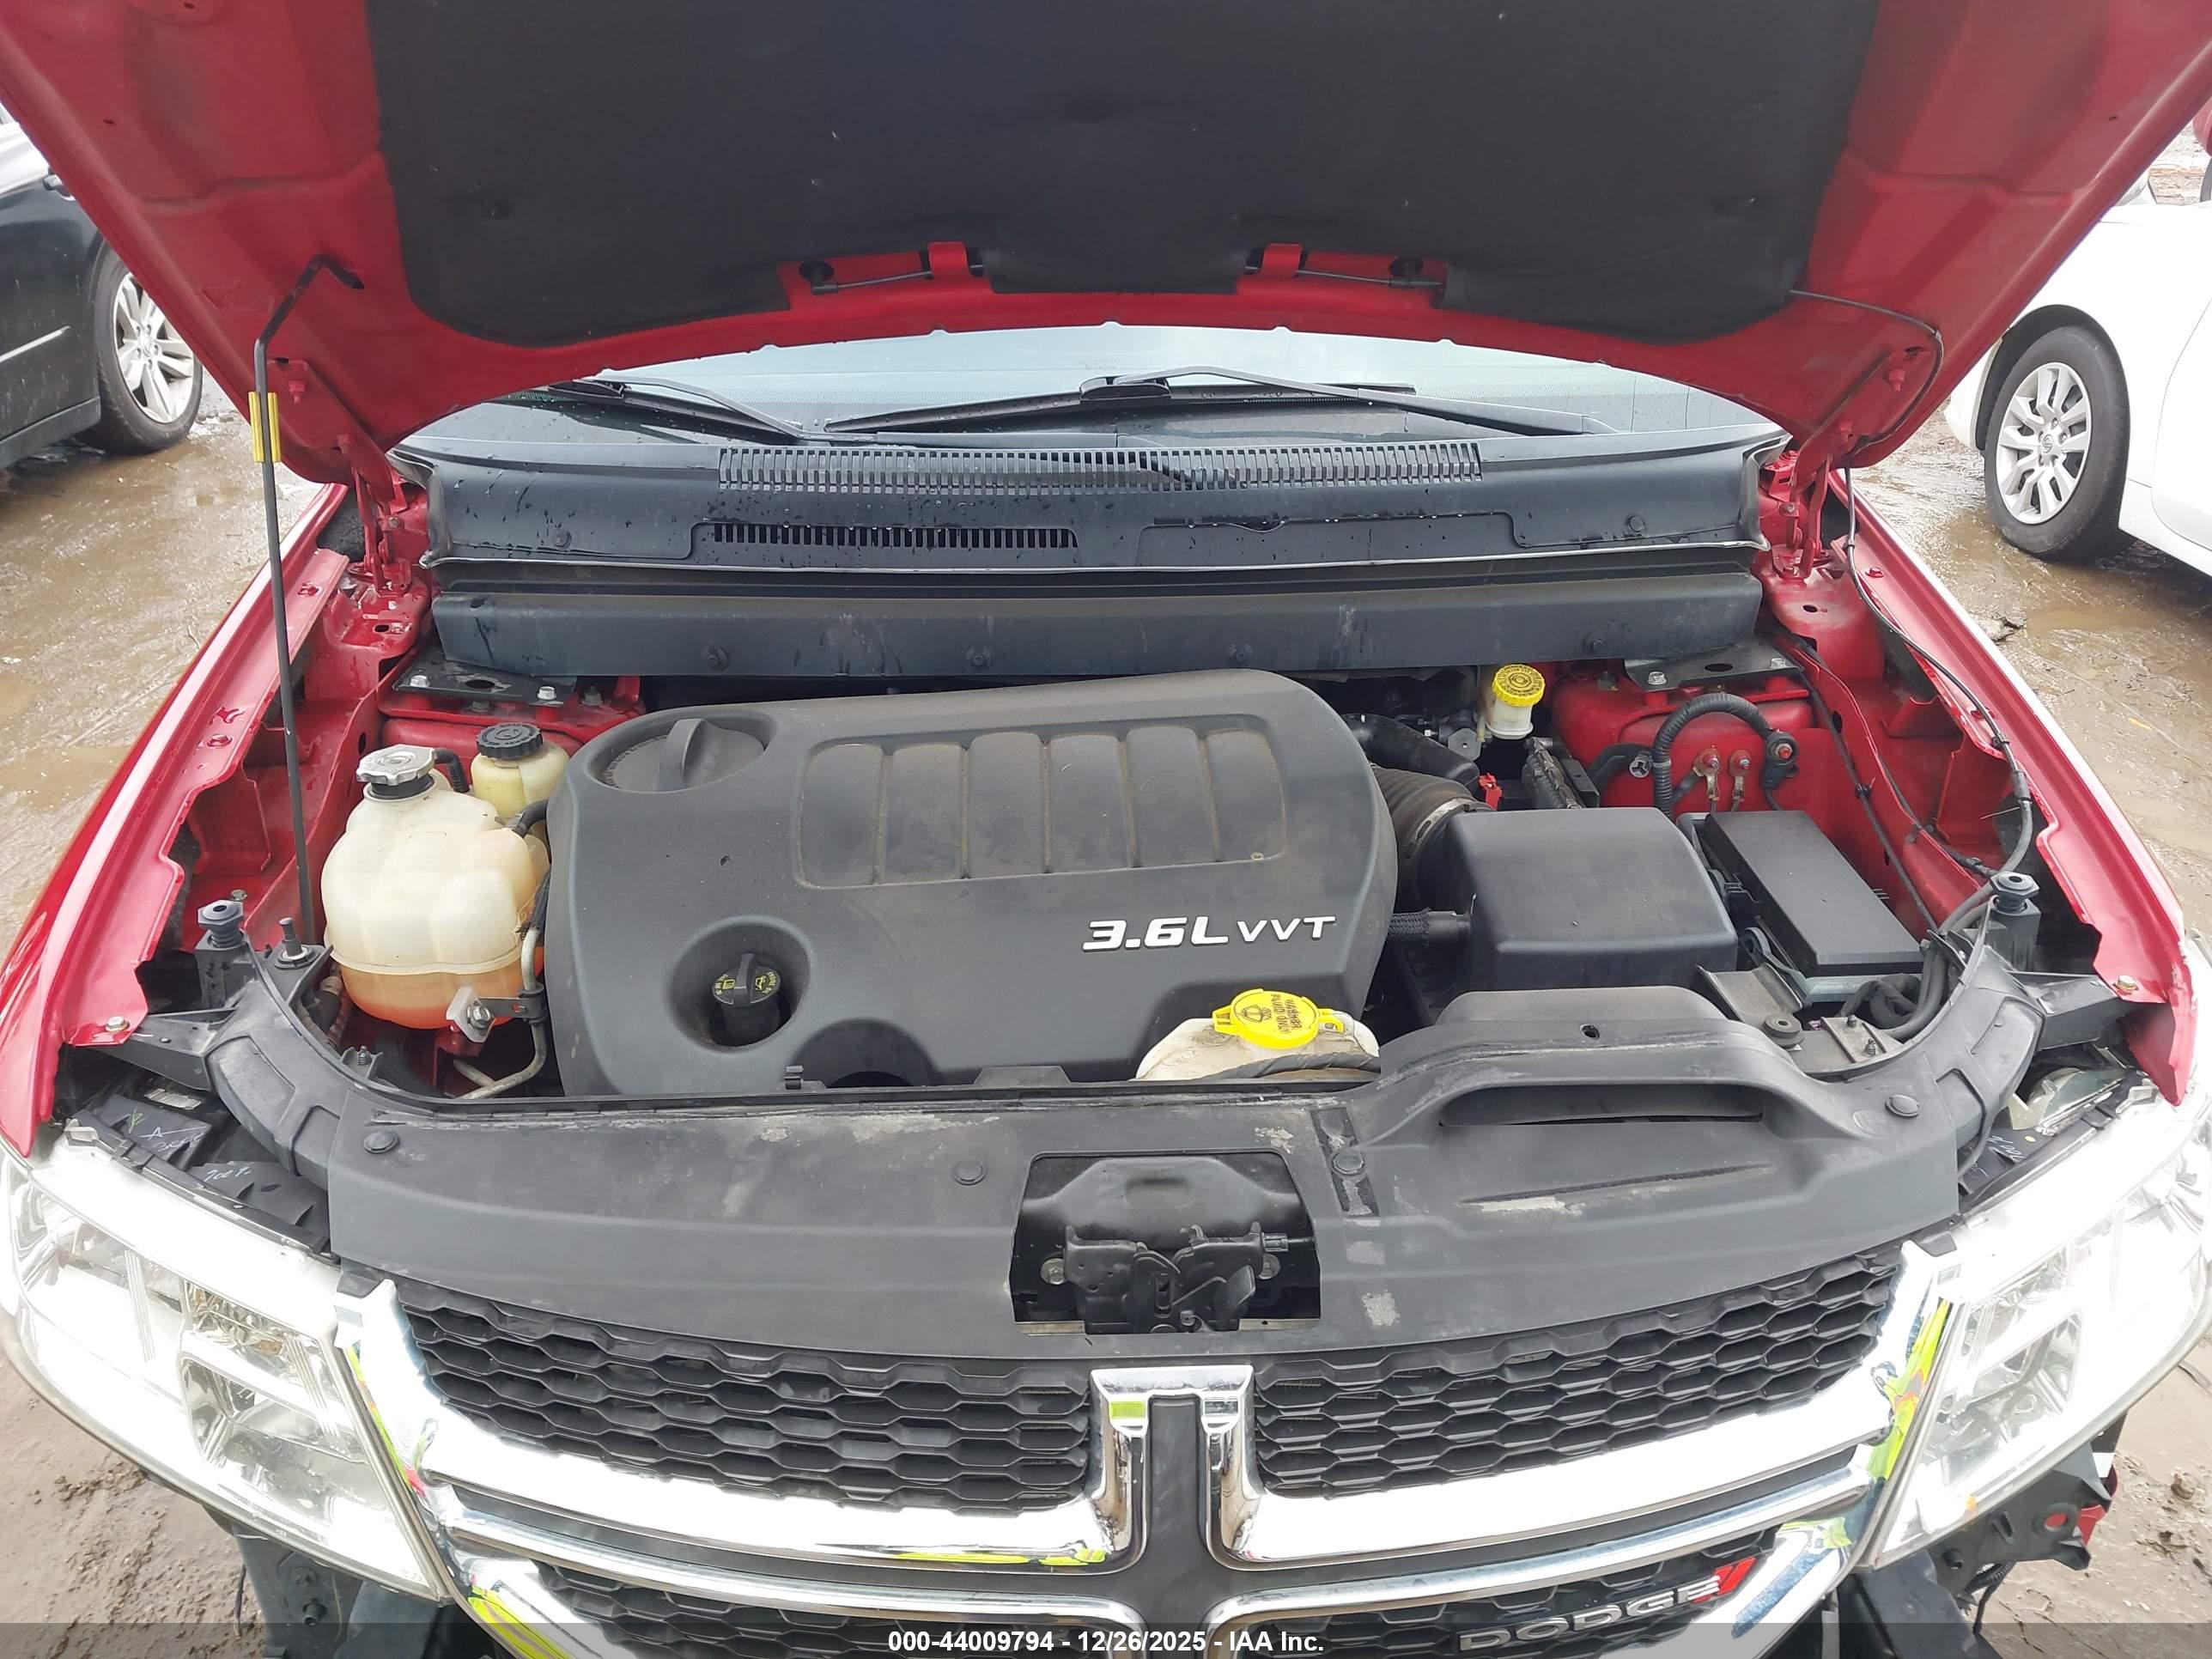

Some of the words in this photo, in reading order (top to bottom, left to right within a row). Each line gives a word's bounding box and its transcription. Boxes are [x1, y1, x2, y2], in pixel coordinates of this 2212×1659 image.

[1082, 916, 1229, 952] 3.6L
[1237, 915, 1336, 942] VVT
[1271, 994, 1285, 1014] FLUID
[1285, 998, 1303, 1030] WASHER
[1277, 1015, 1291, 1034] ONLY
[1459, 1575, 1720, 1651] DODGE
